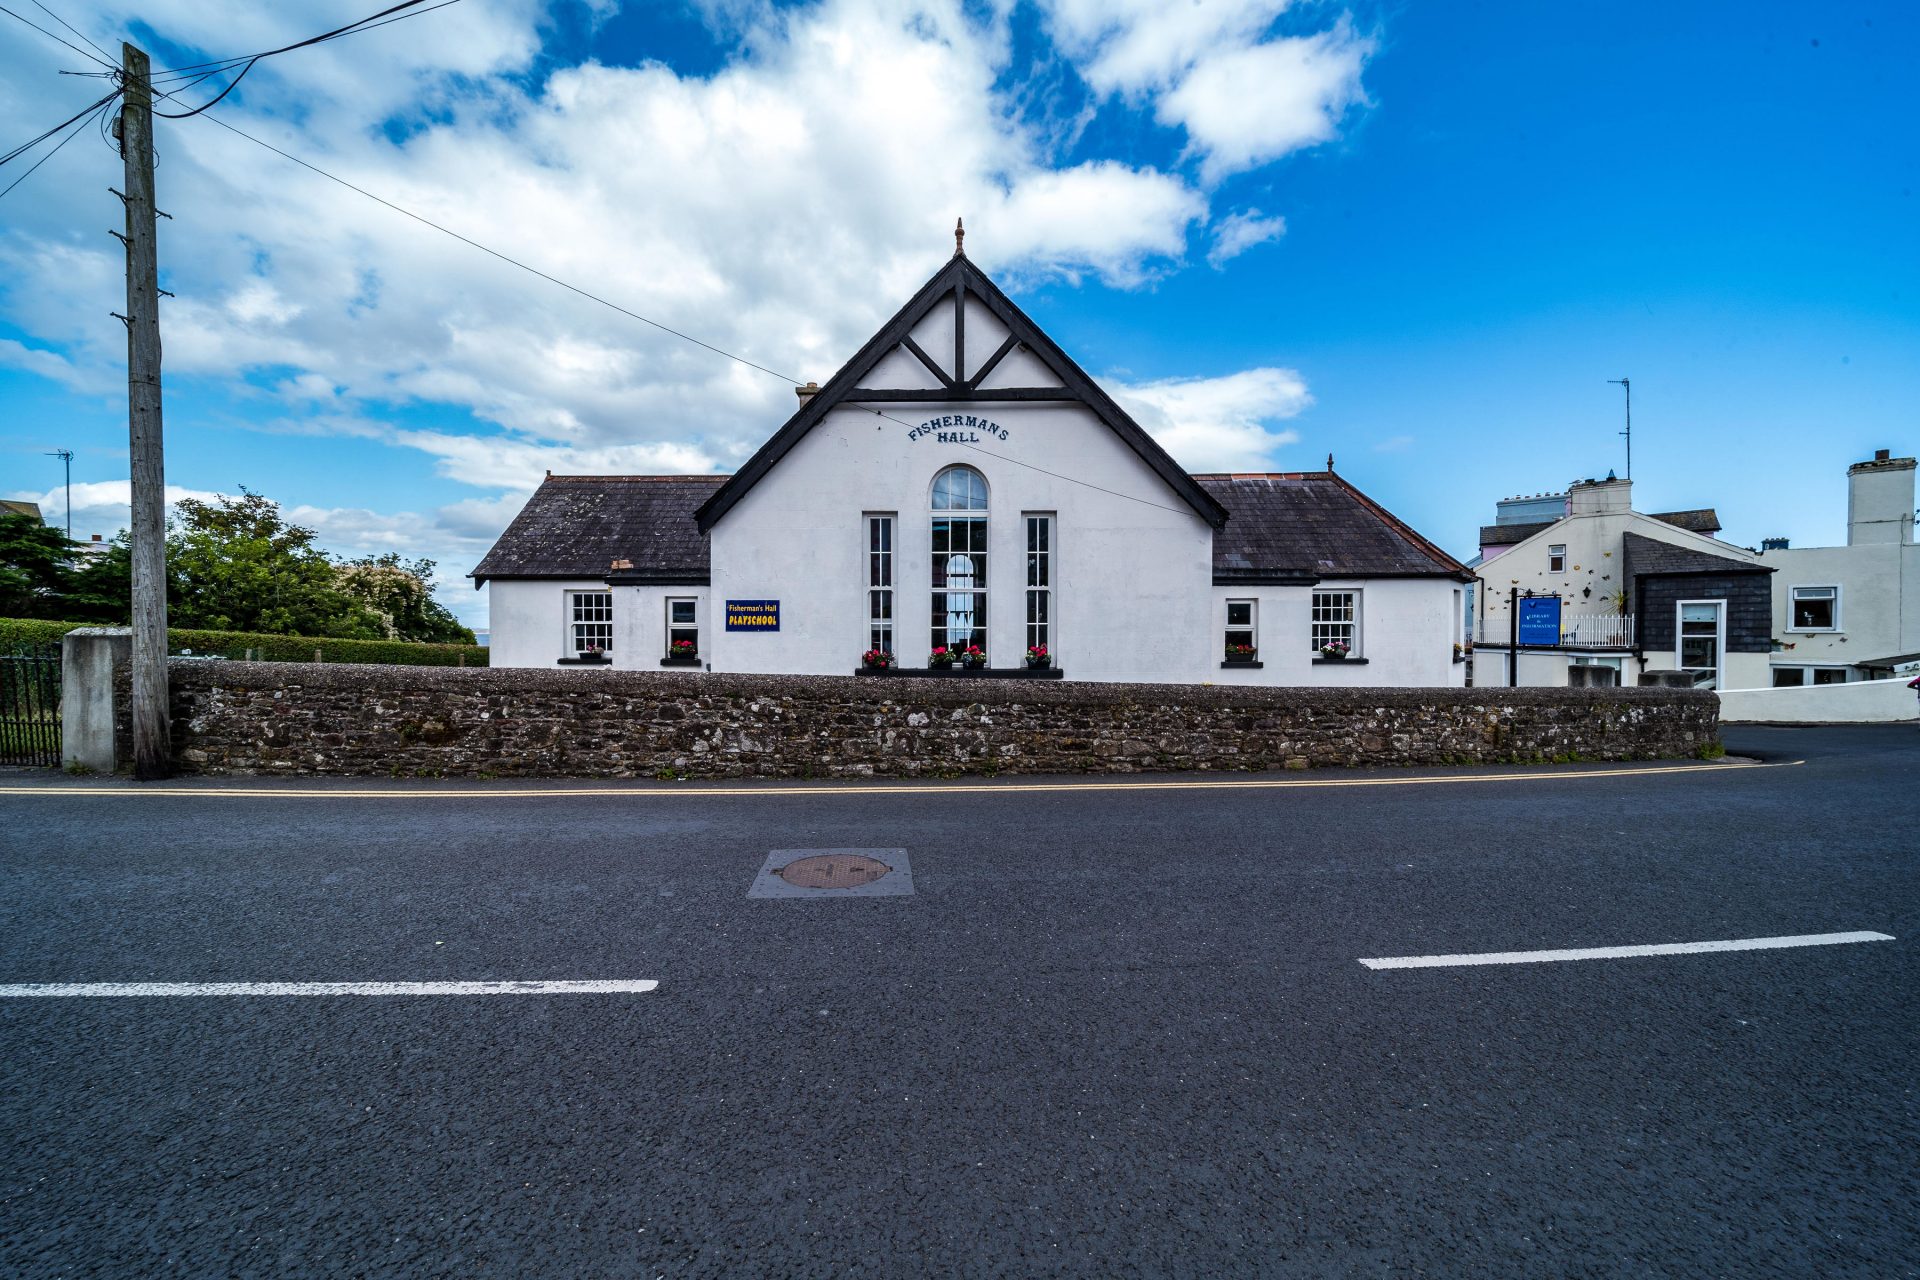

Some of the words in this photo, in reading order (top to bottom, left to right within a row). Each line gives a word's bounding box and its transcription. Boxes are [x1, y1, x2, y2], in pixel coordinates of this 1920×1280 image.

[908, 415, 1009, 441] FISHERMANS
[937, 432, 979, 442] HALL
[729, 604, 763, 612] Fisherman's
[765, 604, 777, 612] Hall
[729, 615, 777, 625] PLAYSCHOOL
